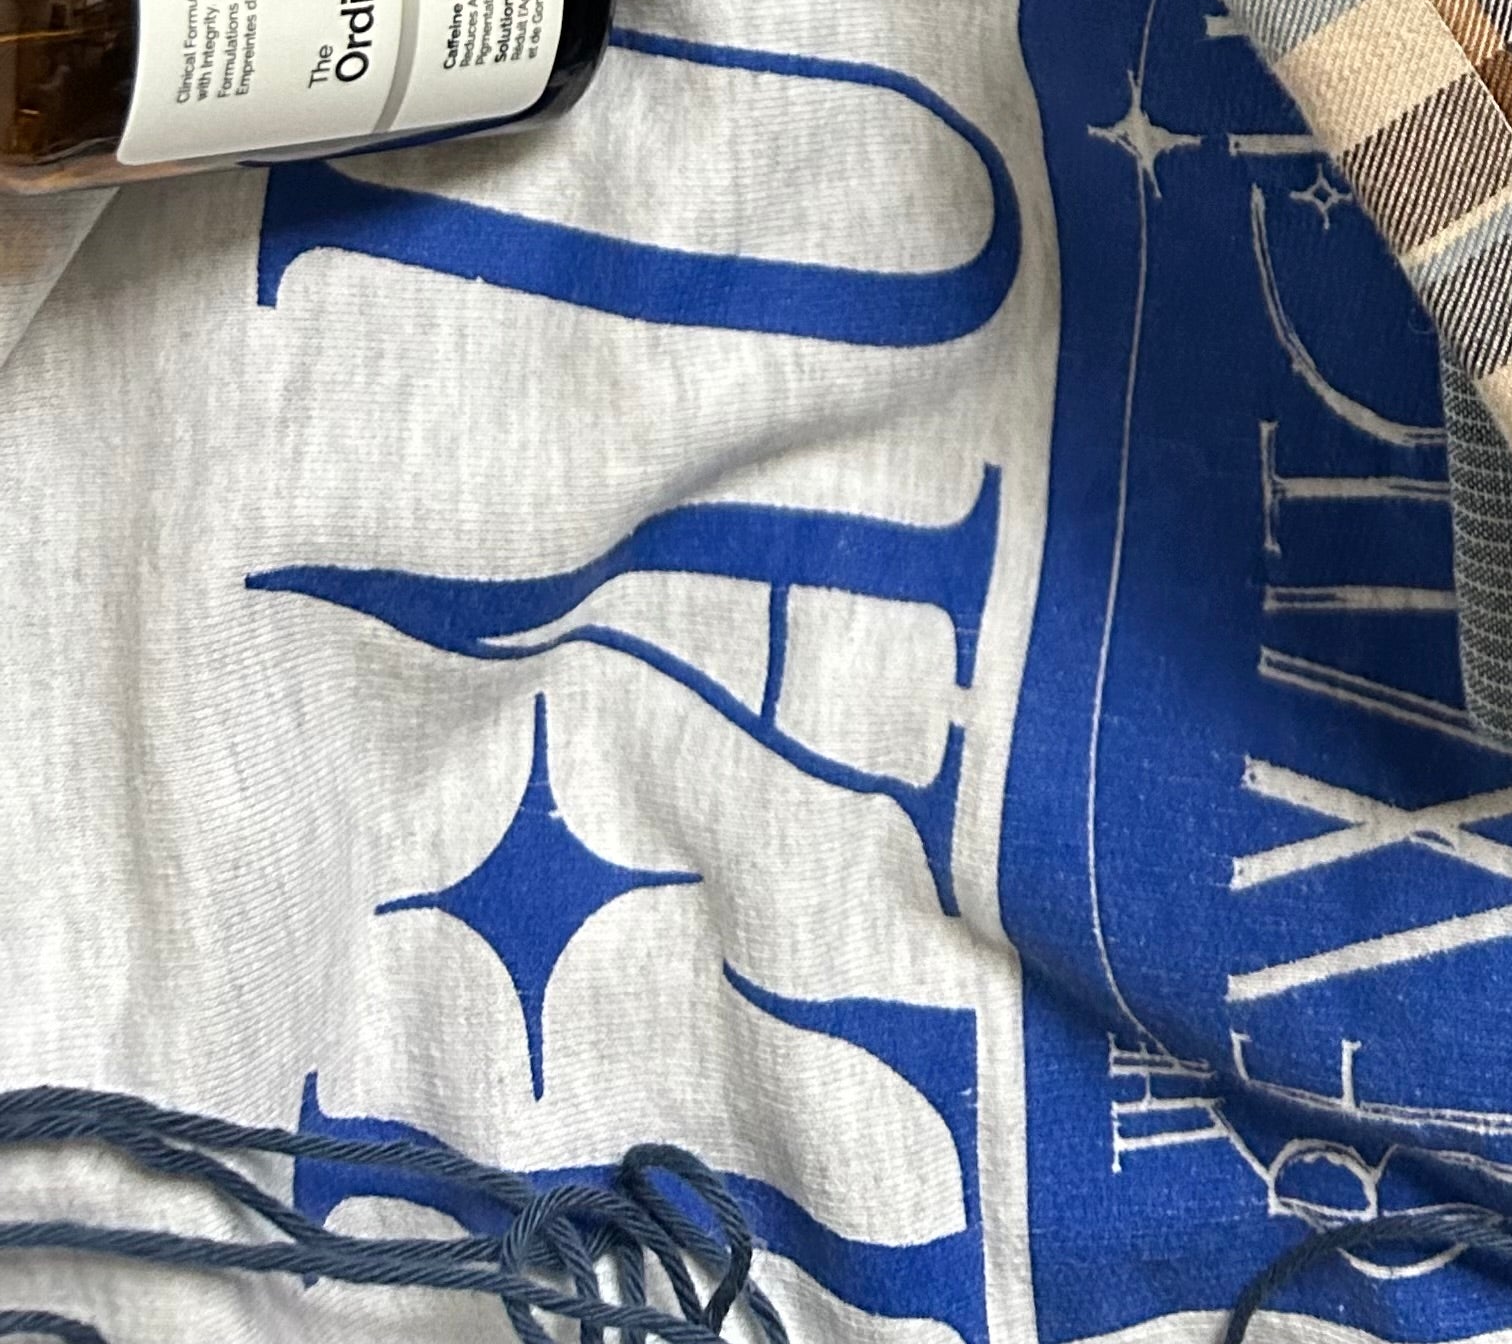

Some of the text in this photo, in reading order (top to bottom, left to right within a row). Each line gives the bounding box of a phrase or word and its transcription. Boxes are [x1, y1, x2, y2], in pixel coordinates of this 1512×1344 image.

[217, 2, 240, 98] Formulations
[235, 13, 257, 95] Empreintes
[443, 3, 463, 69] Caffeine
[459, 10, 478, 67] Reduces
[511, 20, 528, 60] Réduit
[527, 46, 538, 60] et
[530, 26, 542, 44] de
[176, 51, 197, 104] Clinical
[198, 71, 212, 101] with
[308, 44, 333, 89] The
